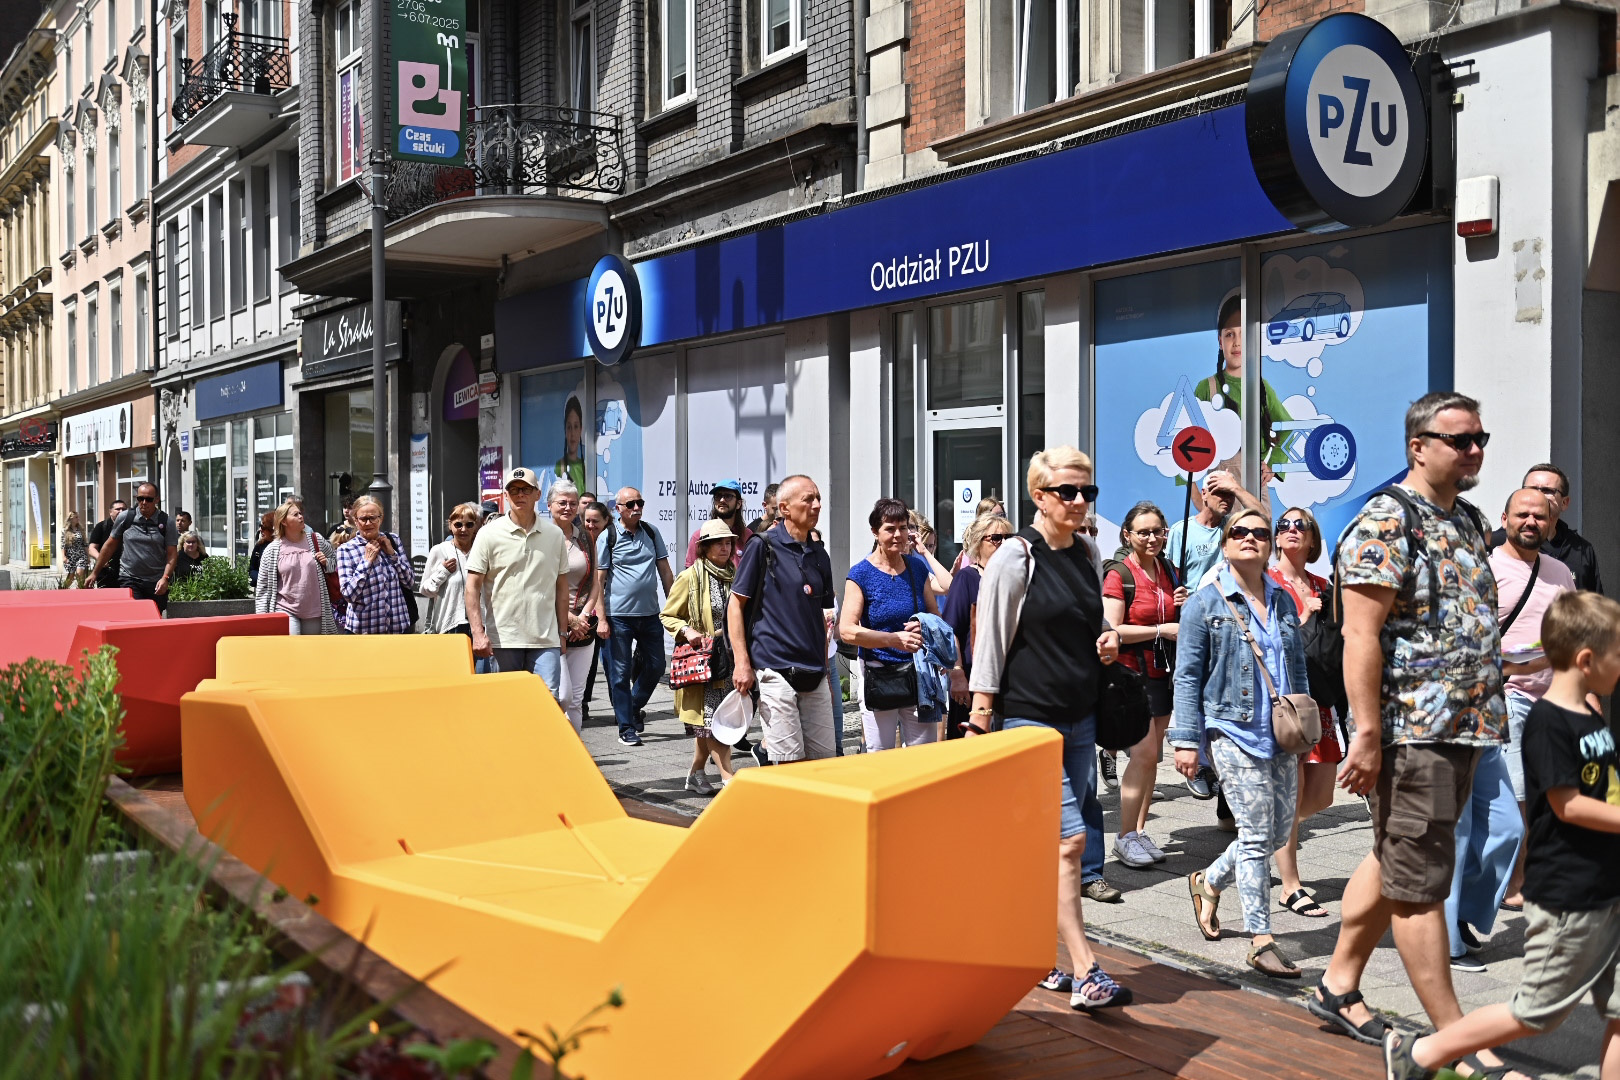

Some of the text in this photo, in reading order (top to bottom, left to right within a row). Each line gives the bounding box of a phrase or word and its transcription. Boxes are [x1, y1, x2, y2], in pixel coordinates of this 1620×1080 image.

[397, 0, 426, 12] 27.06
[409, 11, 460, 30] 6.07.2025
[1318, 75, 1397, 166] PZU
[405, 128, 432, 142] Czas
[412, 141, 446, 155] sztuki
[870, 239, 989, 292] Oddział PZU
[597, 286, 624, 334] PZU
[323, 306, 374, 356] La Strada
[658, 480, 665, 497] Z
[666, 480, 677, 497] PZ
[688, 479, 710, 496] Auto
